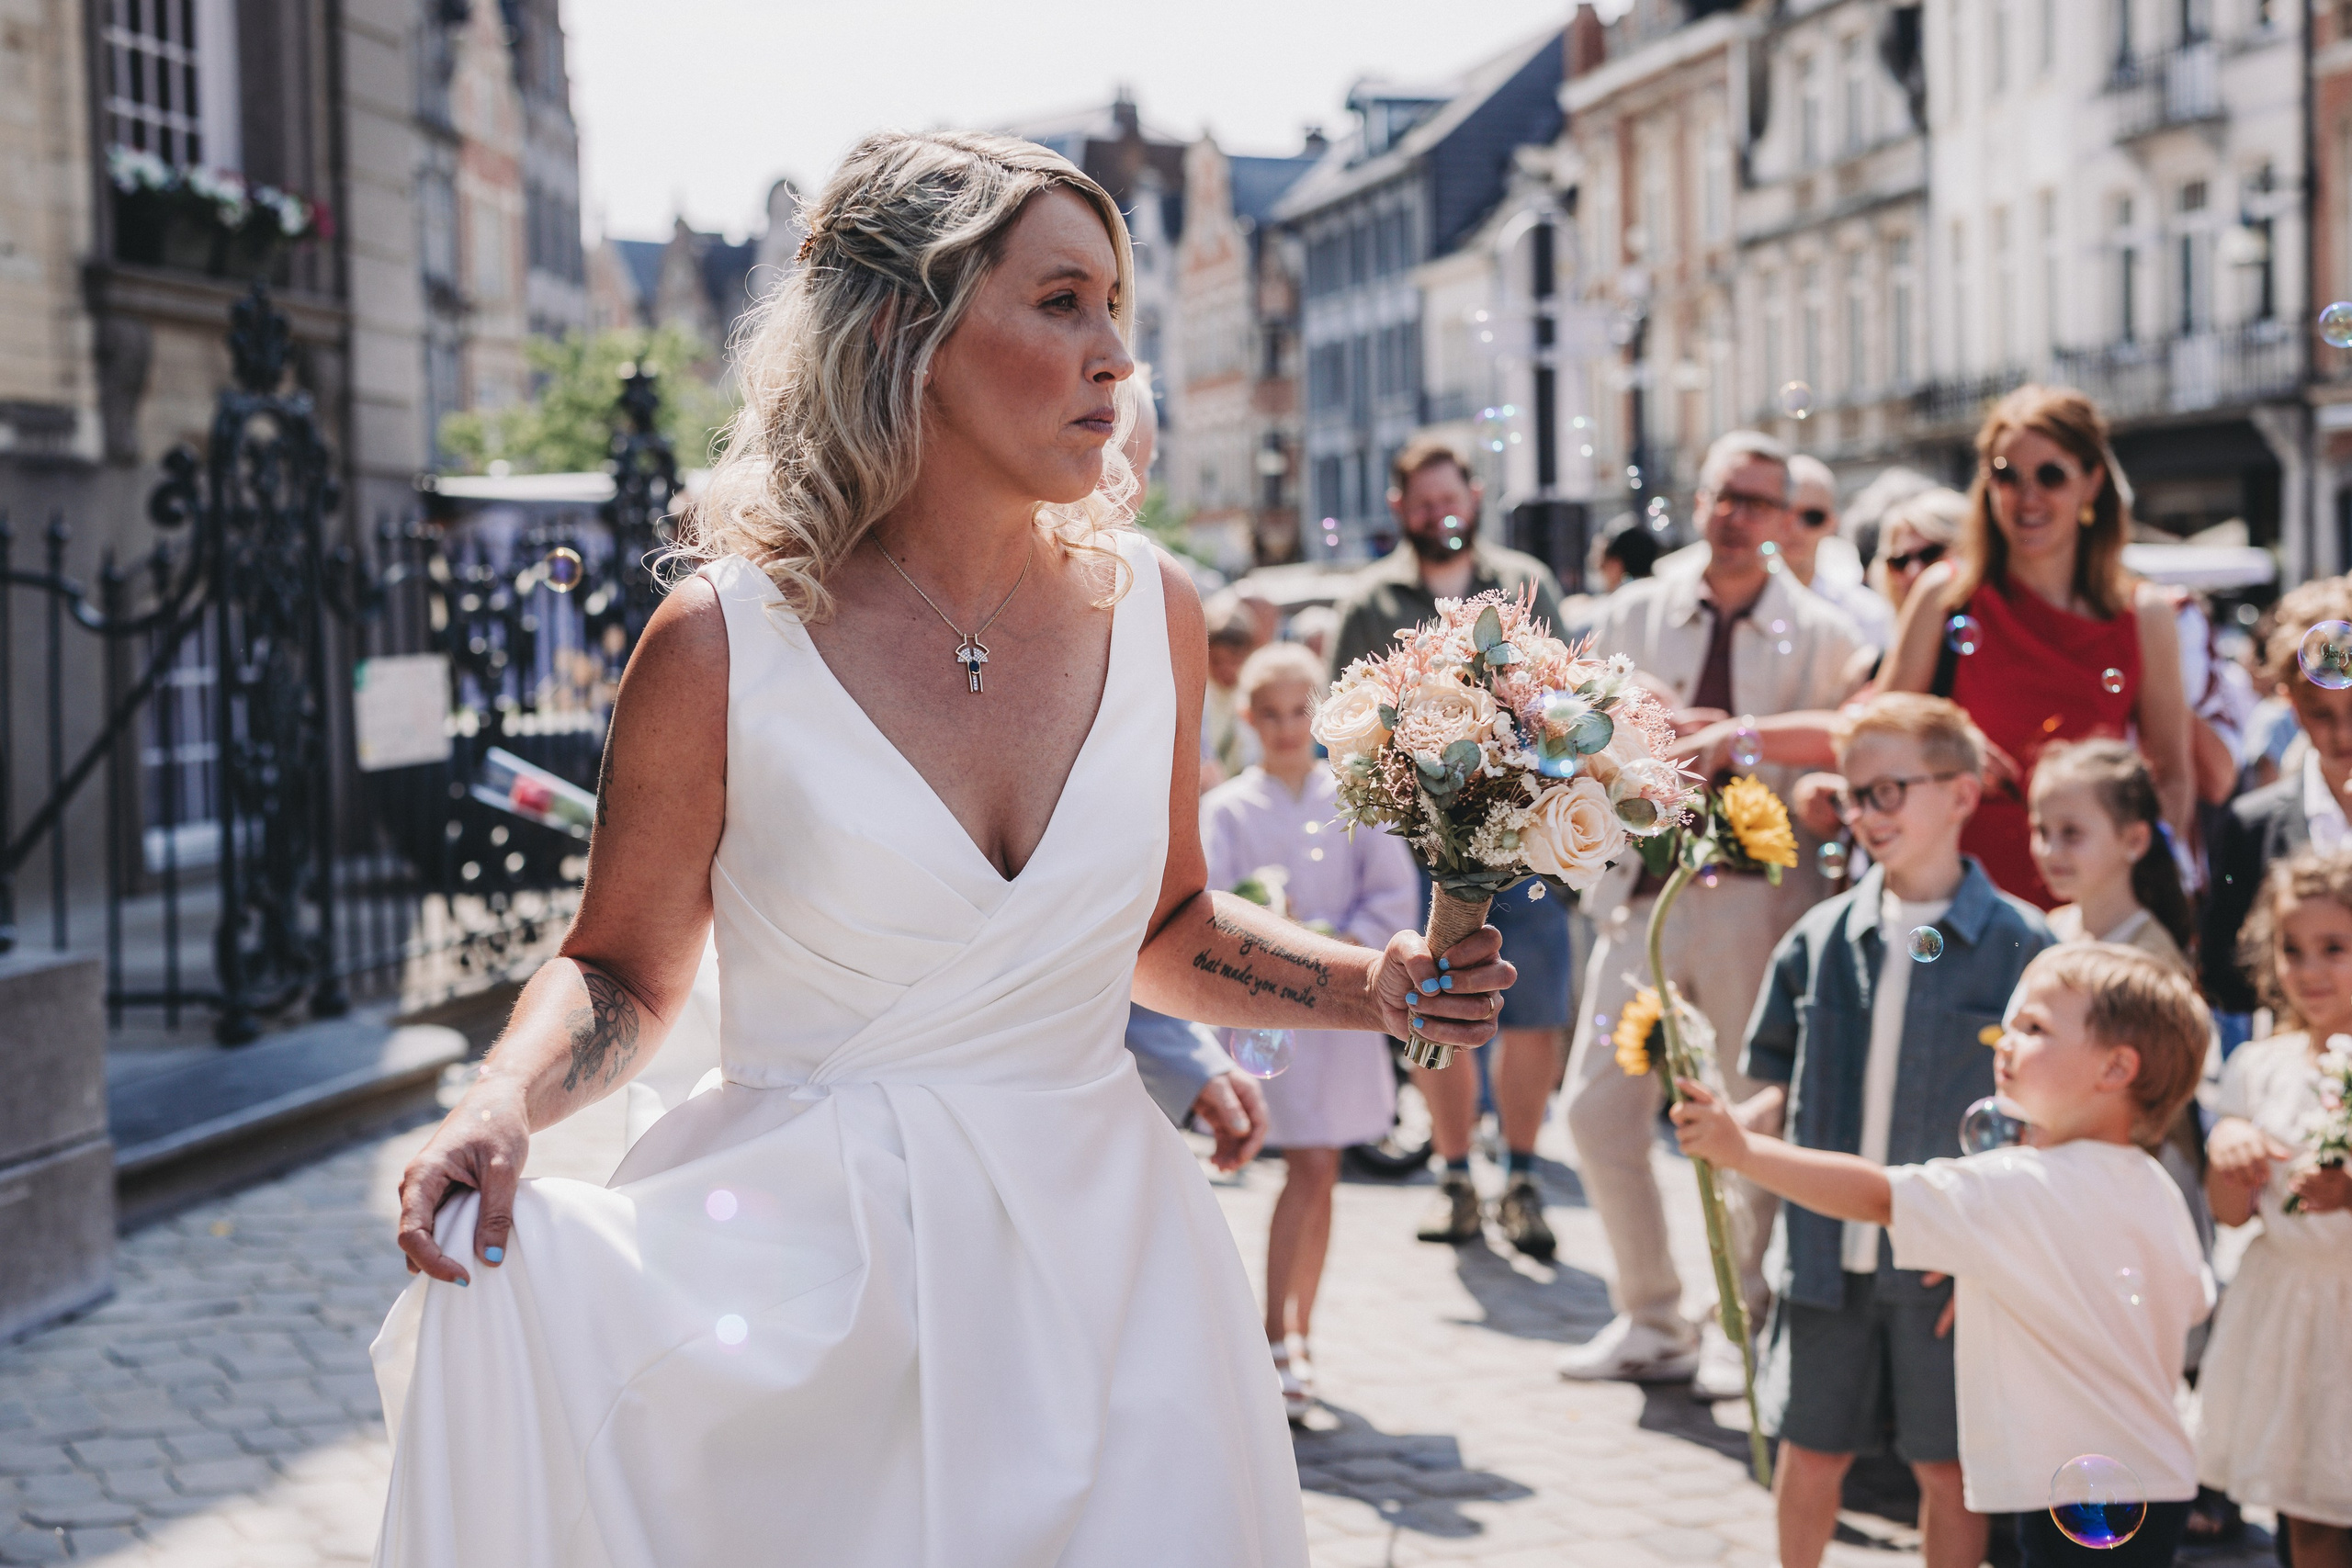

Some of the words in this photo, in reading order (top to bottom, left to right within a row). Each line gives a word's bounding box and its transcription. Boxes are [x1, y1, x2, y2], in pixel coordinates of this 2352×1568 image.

[1193, 948, 1222, 974] that
[1219, 964, 1253, 986] made
[1249, 976, 1278, 996] you
[1280, 985, 1316, 1009] smile
